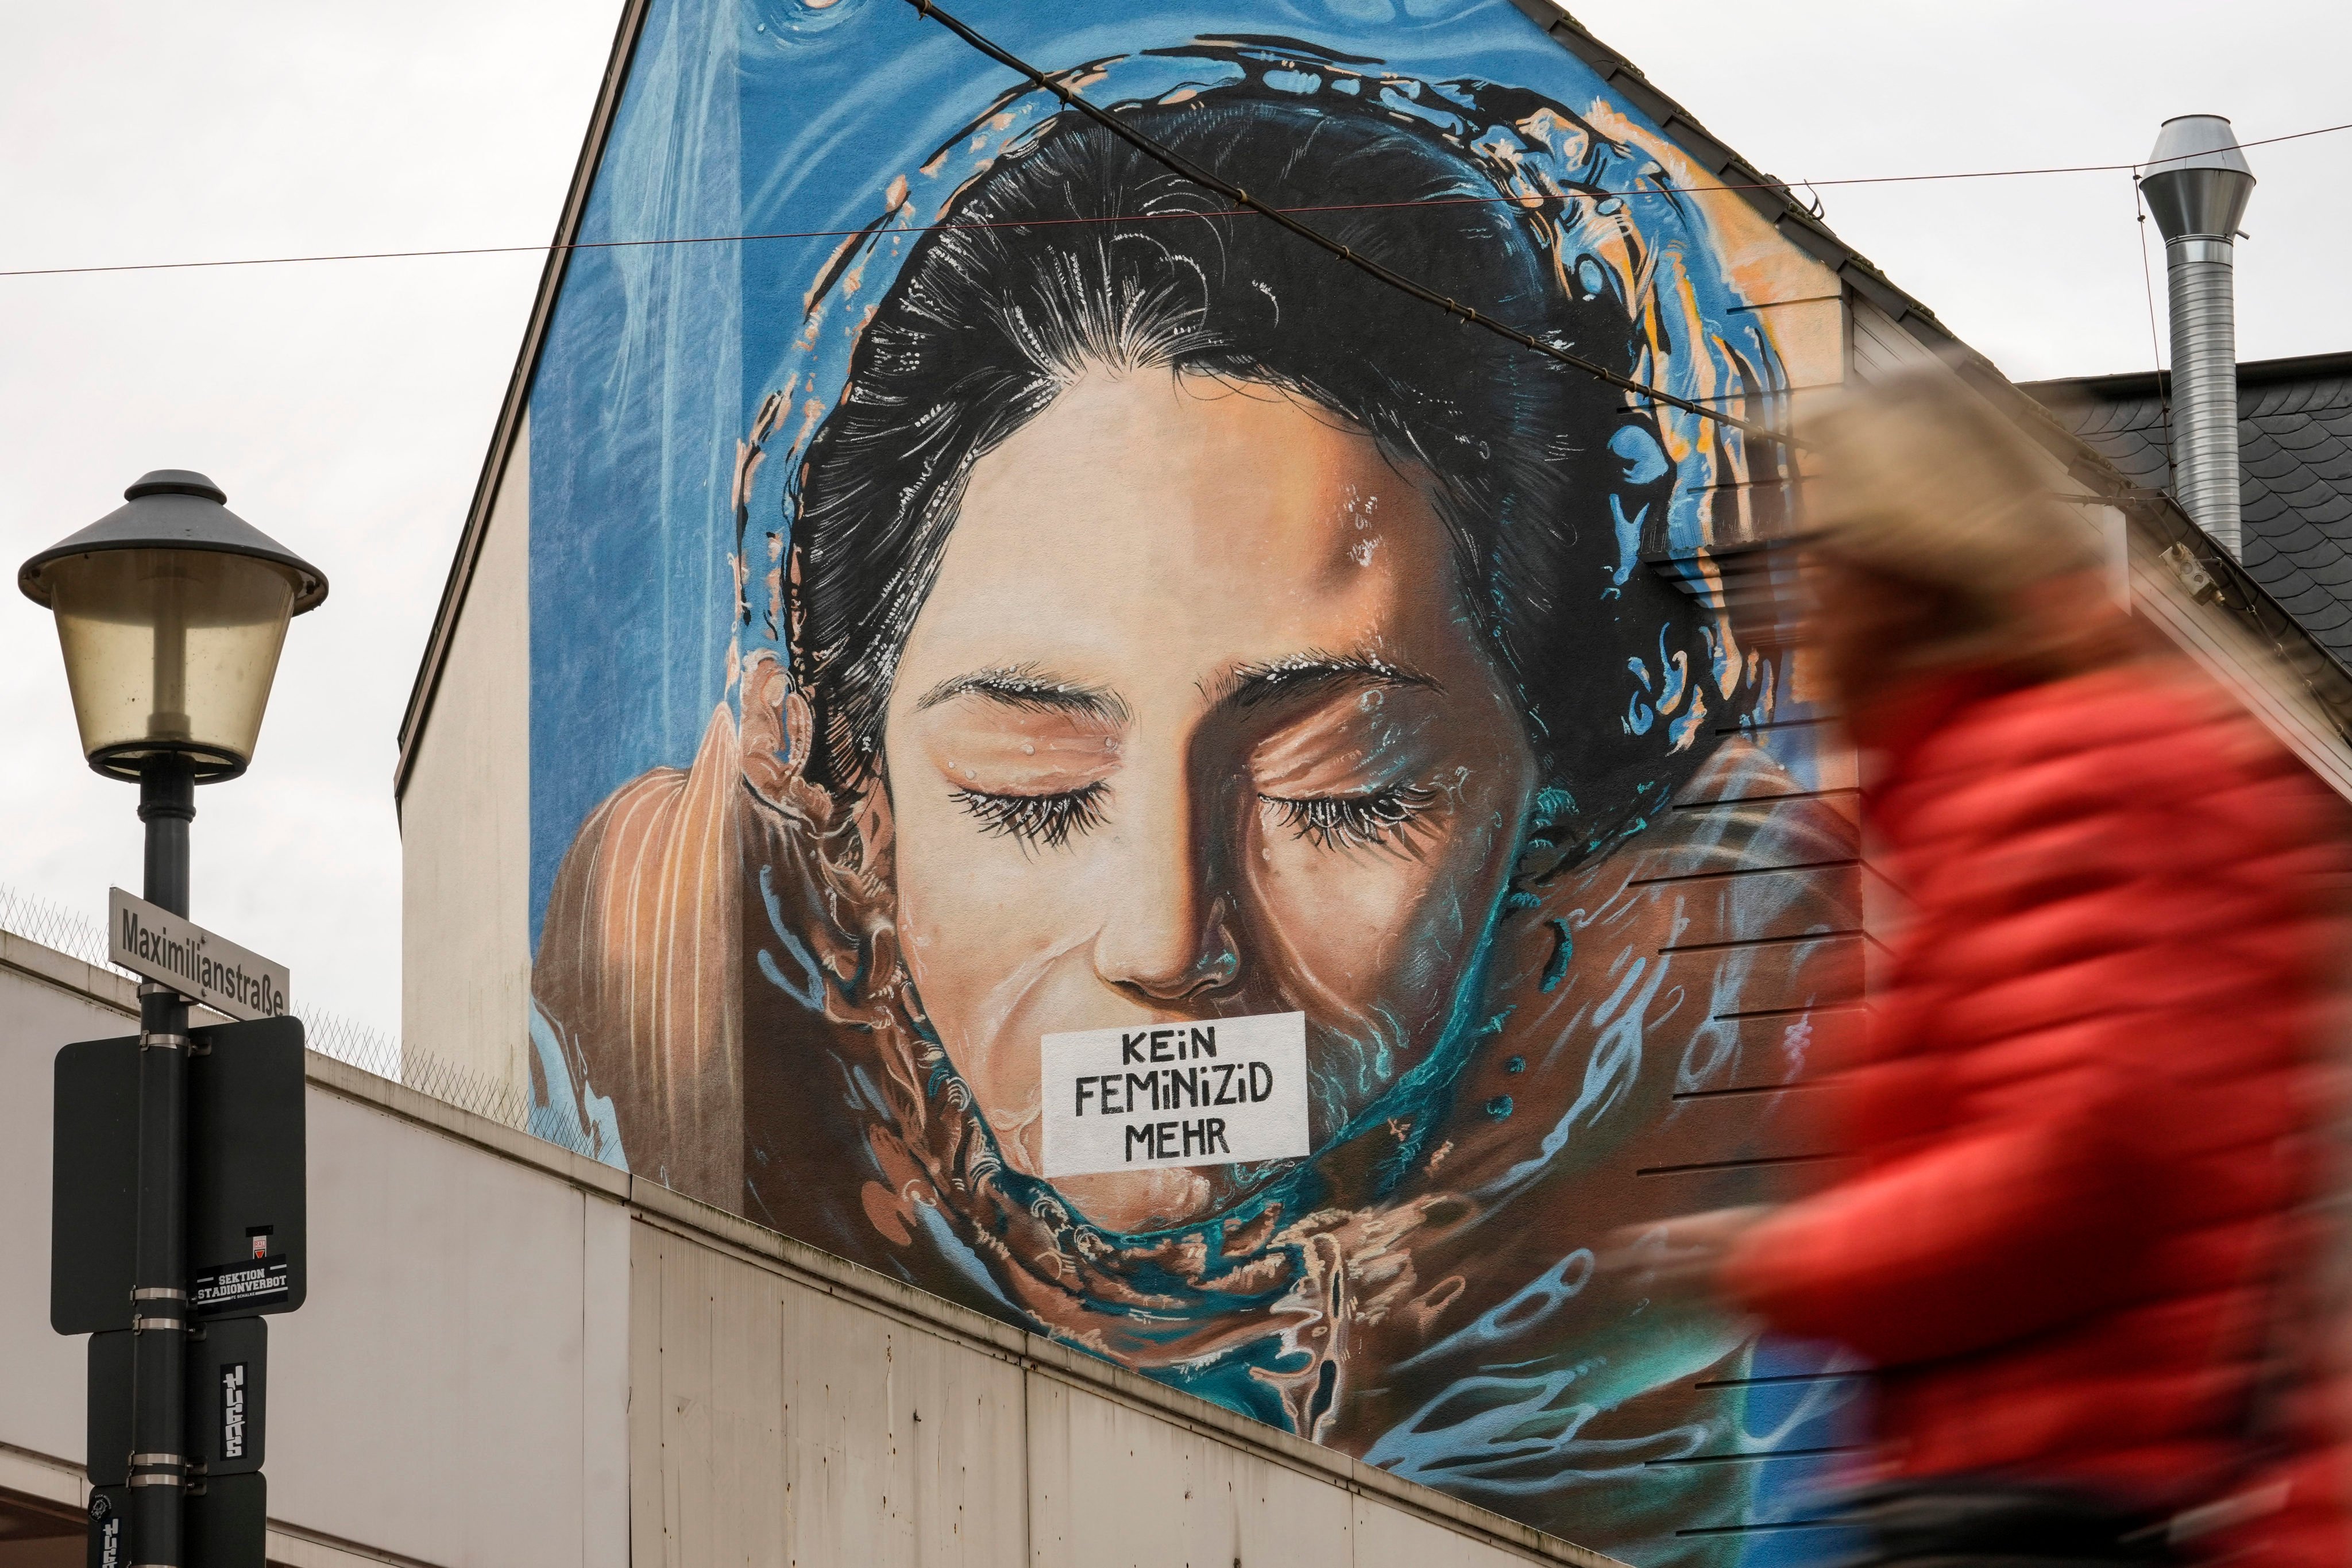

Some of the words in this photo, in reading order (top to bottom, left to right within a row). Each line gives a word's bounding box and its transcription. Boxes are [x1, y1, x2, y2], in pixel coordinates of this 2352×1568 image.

[122, 908, 284, 1017] Maximilianstraße
[1125, 1118, 1230, 1162] MEHR
[198, 1275, 287, 1299] STADIONVERBOT
[219, 1268, 265, 1285] SEKTION
